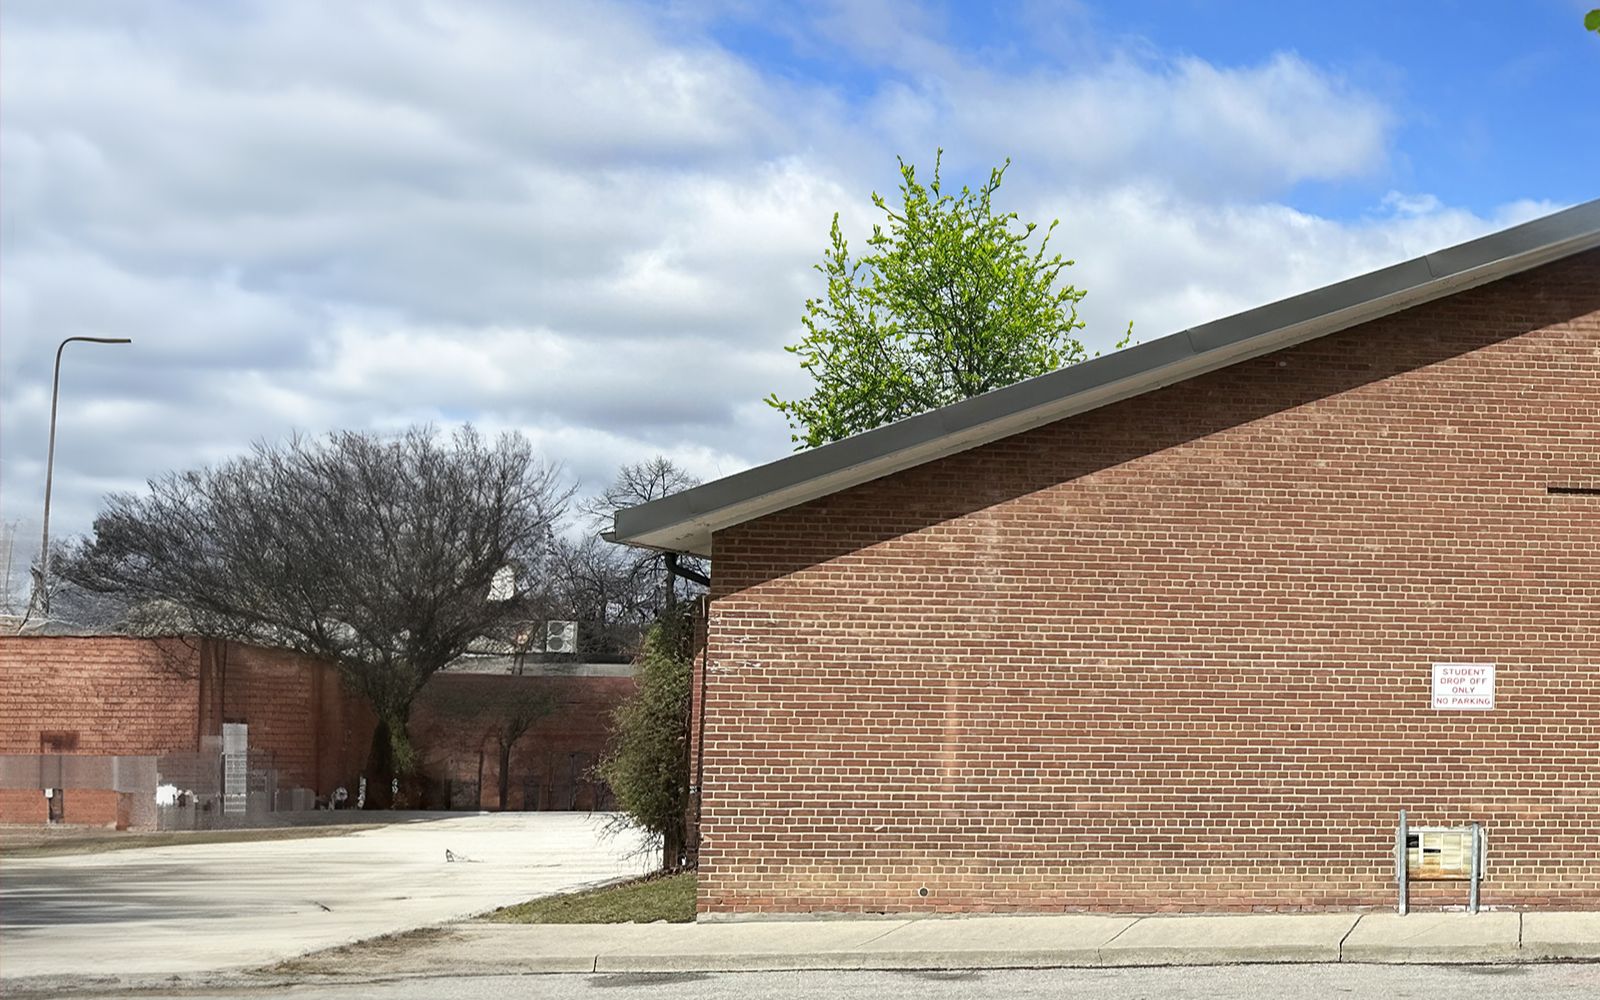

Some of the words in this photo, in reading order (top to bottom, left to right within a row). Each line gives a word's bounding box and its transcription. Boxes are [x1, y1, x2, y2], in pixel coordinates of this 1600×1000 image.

[1442, 668, 1486, 676] STUDENT
[1440, 677, 1466, 685] DROP
[1469, 677, 1488, 685] OFF
[1451, 686, 1475, 694] ONLY
[1436, 697, 1449, 705] NO
[1452, 697, 1491, 705] PARKING
